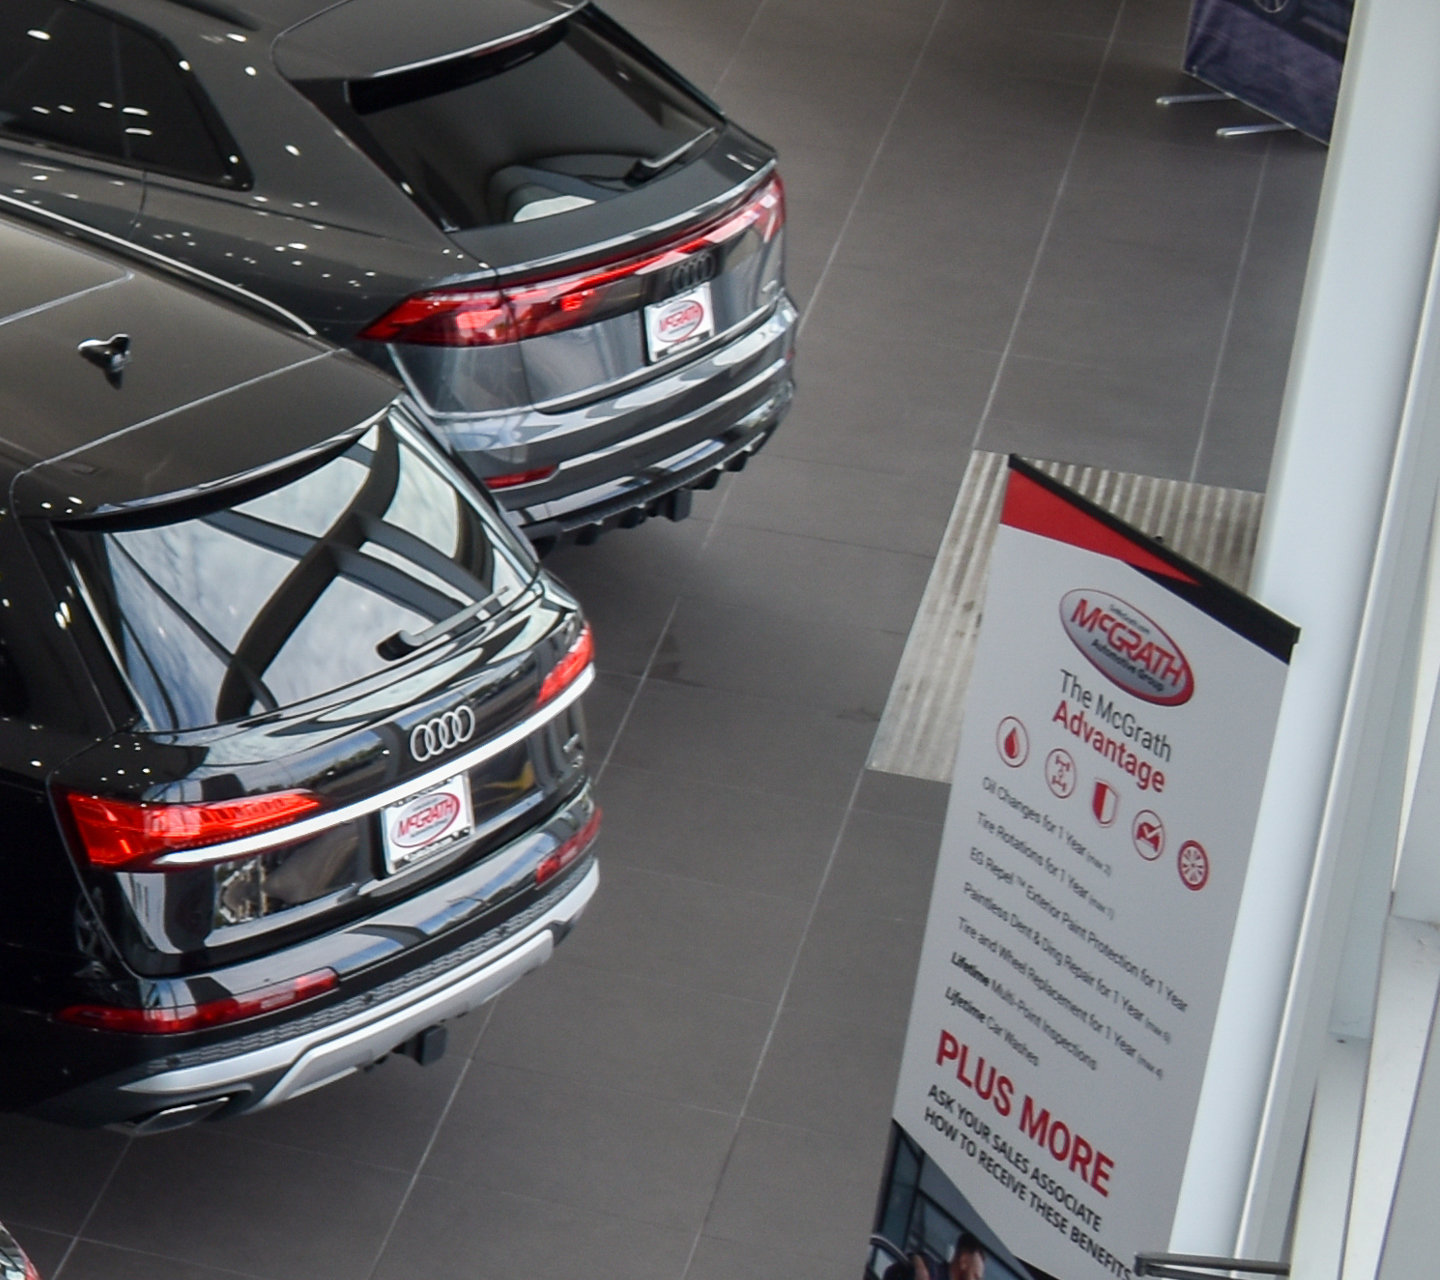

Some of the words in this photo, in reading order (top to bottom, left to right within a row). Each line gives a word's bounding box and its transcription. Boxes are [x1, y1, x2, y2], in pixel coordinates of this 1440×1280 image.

[1052, 700, 1166, 793] Advantage
[1060, 669, 1092, 709] The
[1096, 694, 1172, 763] McGrath
[977, 811, 994, 833] Tire
[996, 825, 1043, 866] Rotations
[1045, 858, 1058, 876] for
[1068, 875, 1088, 900] Year
[982, 776, 995, 794] Oil
[997, 786, 1041, 823] Changes
[1043, 815, 1056, 833] for
[1066, 832, 1086, 857] Year
[958, 916, 977, 939] Tire
[978, 929, 998, 953] and
[998, 943, 1027, 977] Wheel
[1028, 966, 1088, 1023] Replacement
[1089, 1014, 1103, 1033] for
[1113, 1031, 1136, 1058] Year
[964, 882, 1008, 922] Paintless
[1010, 914, 1032, 937] Dent
[1041, 937, 1063, 967] Ding
[1064, 955, 1095, 987] Repair
[1096, 978, 1111, 998] for
[1121, 996, 1144, 1022] Year
[986, 856, 1014, 886] Repel
[1026, 885, 1061, 920] Exterior
[1061, 911, 1087, 941] Paint
[1088, 931, 1139, 977] Protection
[1141, 968, 1155, 989] for
[1165, 985, 1188, 1013] Year
[945, 986, 986, 1023] Lifetime
[986, 1016, 1003, 1037] Car
[1004, 1029, 1039, 1067] Washes
[951, 951, 990, 988] Lifetime
[990, 979, 1041, 1028] Multi-Point
[1042, 1019, 1097, 1071] Inspections
[925, 1107, 957, 1143] HOW
[960, 1132, 977, 1159] TO
[978, 1150, 1028, 1200] RECEIVE
[1030, 1190, 1068, 1235] THESE
[928, 1084, 954, 1113] ASK
[956, 1103, 992, 1147] YOUR
[993, 1133, 1030, 1175] SALES
[1030, 1167, 1102, 1233] ASSOCIATE
[936, 1029, 1014, 1117] PLUS
[1019, 1095, 1115, 1198] MORE
